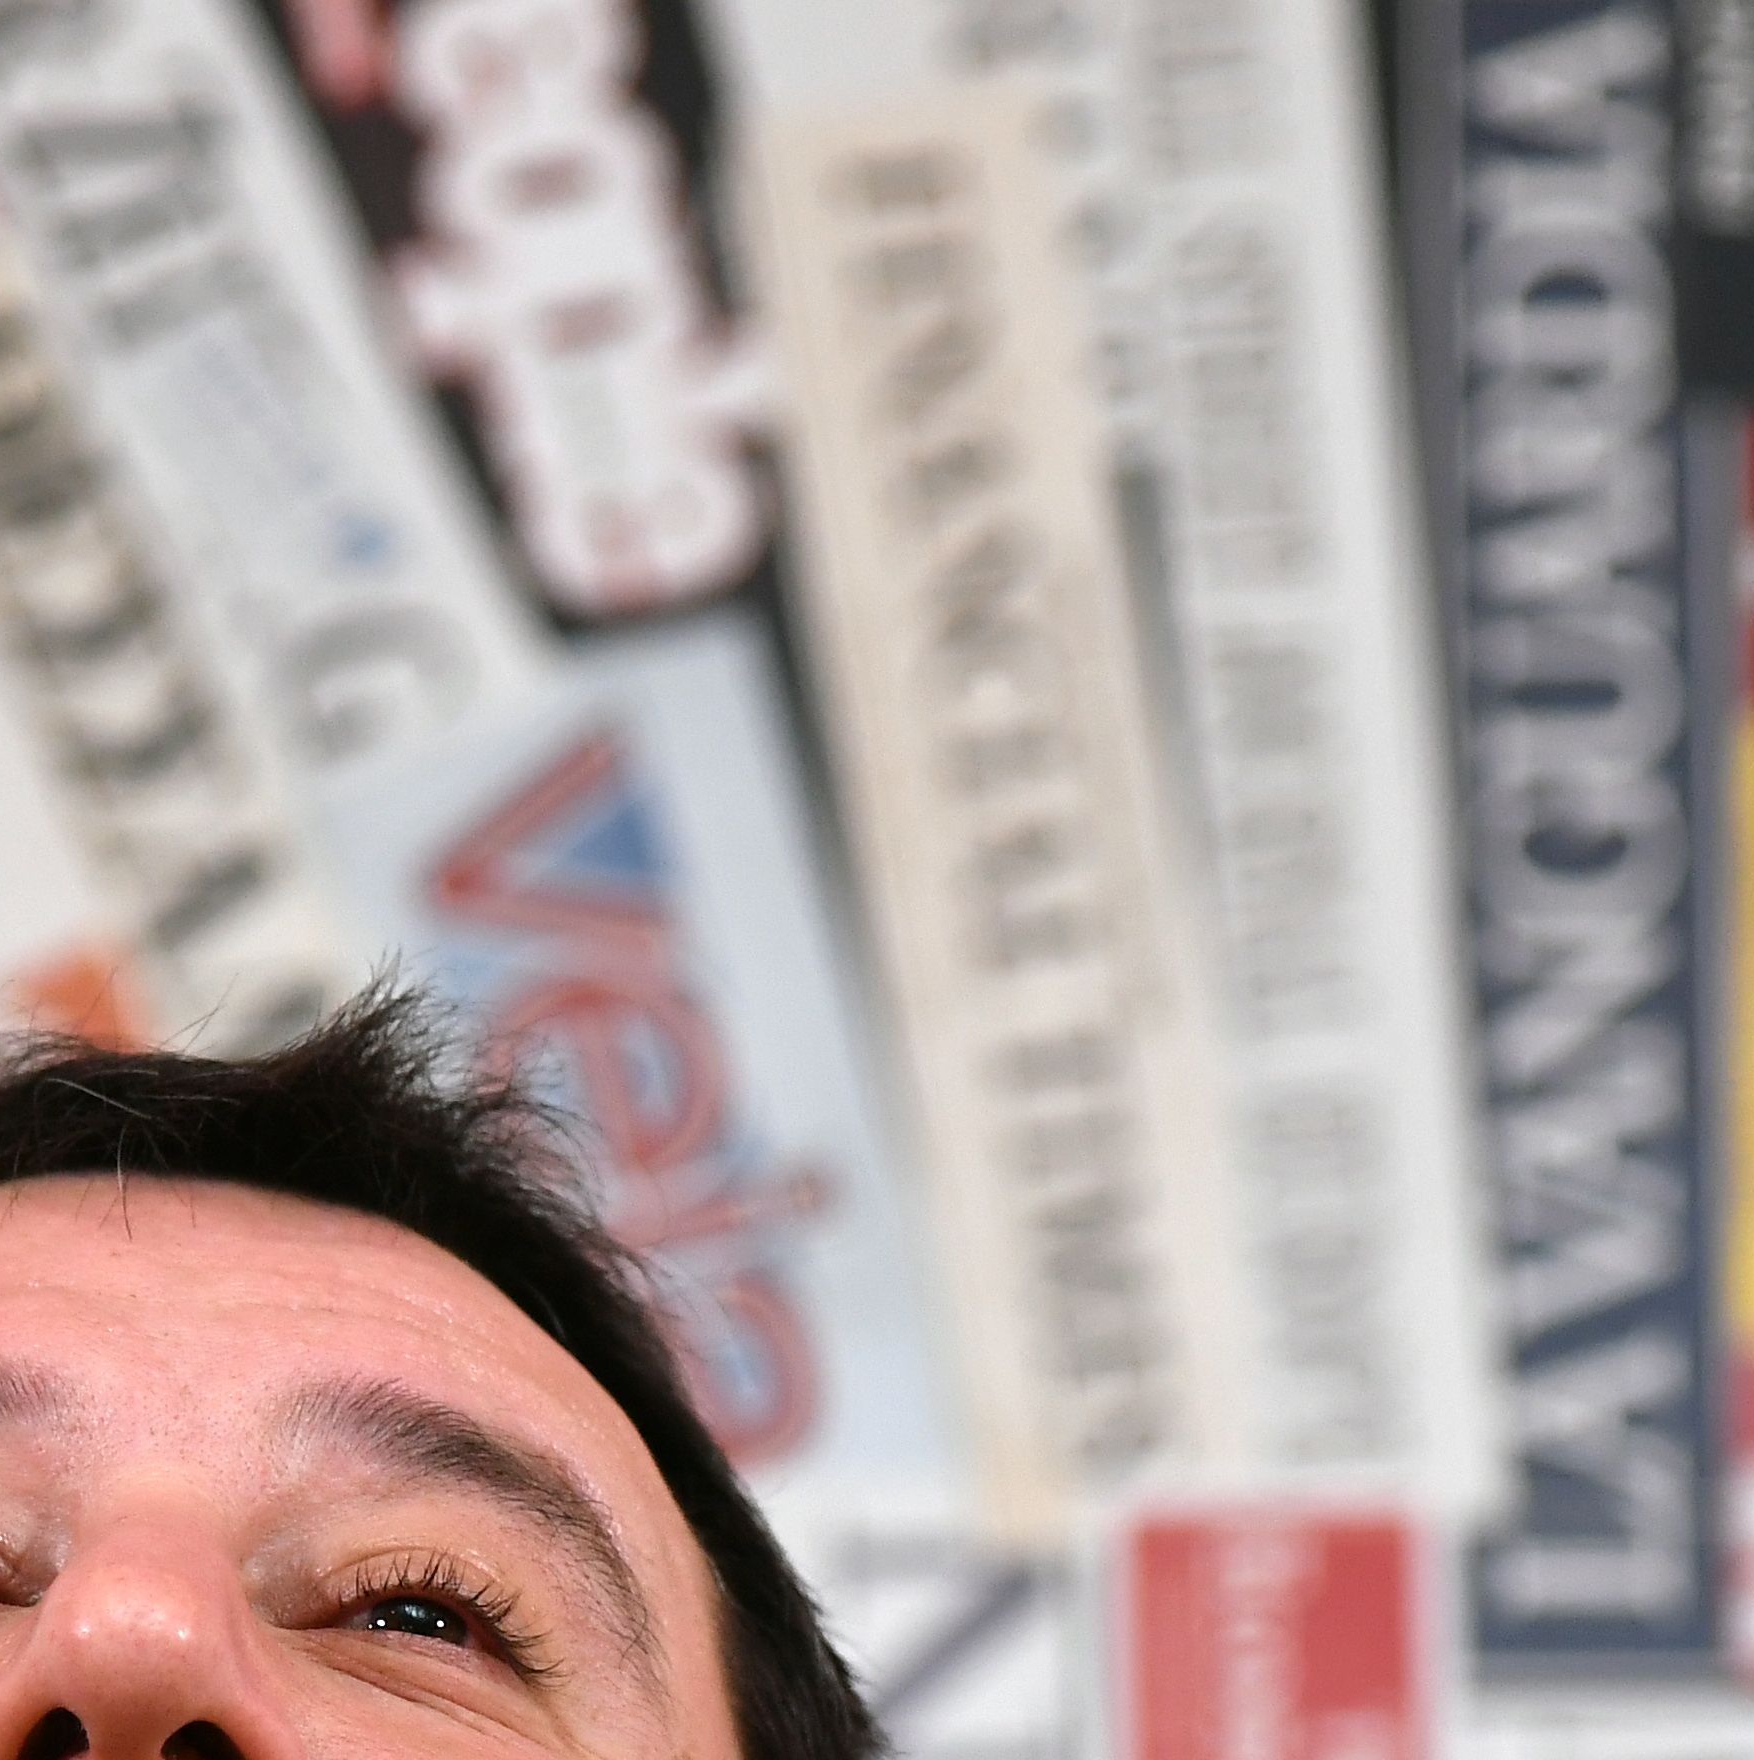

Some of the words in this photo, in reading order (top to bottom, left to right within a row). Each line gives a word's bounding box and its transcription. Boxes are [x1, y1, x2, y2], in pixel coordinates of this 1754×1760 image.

[828, 138, 1113, 972] FINANCIAL
[985, 1020, 1185, 1472] TIMES
[1465, 5, 1695, 1370] VANGUARDIA
[1485, 1335, 1700, 1630] LA
